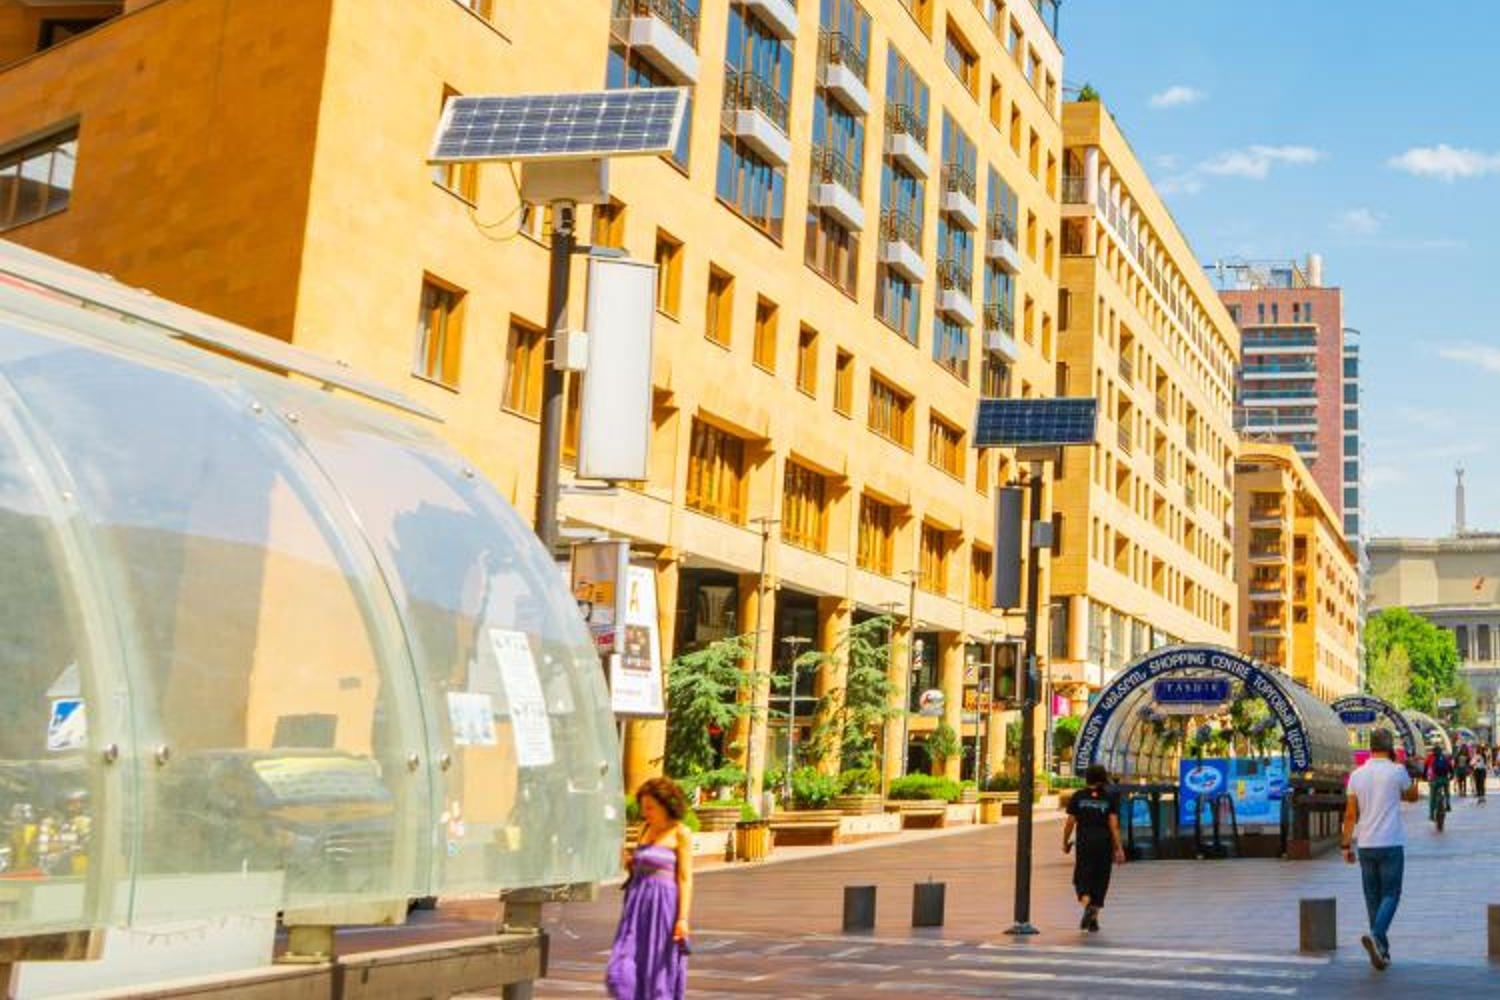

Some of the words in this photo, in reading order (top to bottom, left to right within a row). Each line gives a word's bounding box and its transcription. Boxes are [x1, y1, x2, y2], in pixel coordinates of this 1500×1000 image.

[1149, 652, 1207, 674] SHOPPING
[1211, 655, 1252, 680] CENTRE
[1253, 673, 1297, 728] ТОРГОВЫЙ
[1287, 727, 1307, 768] ЦЕНТР
